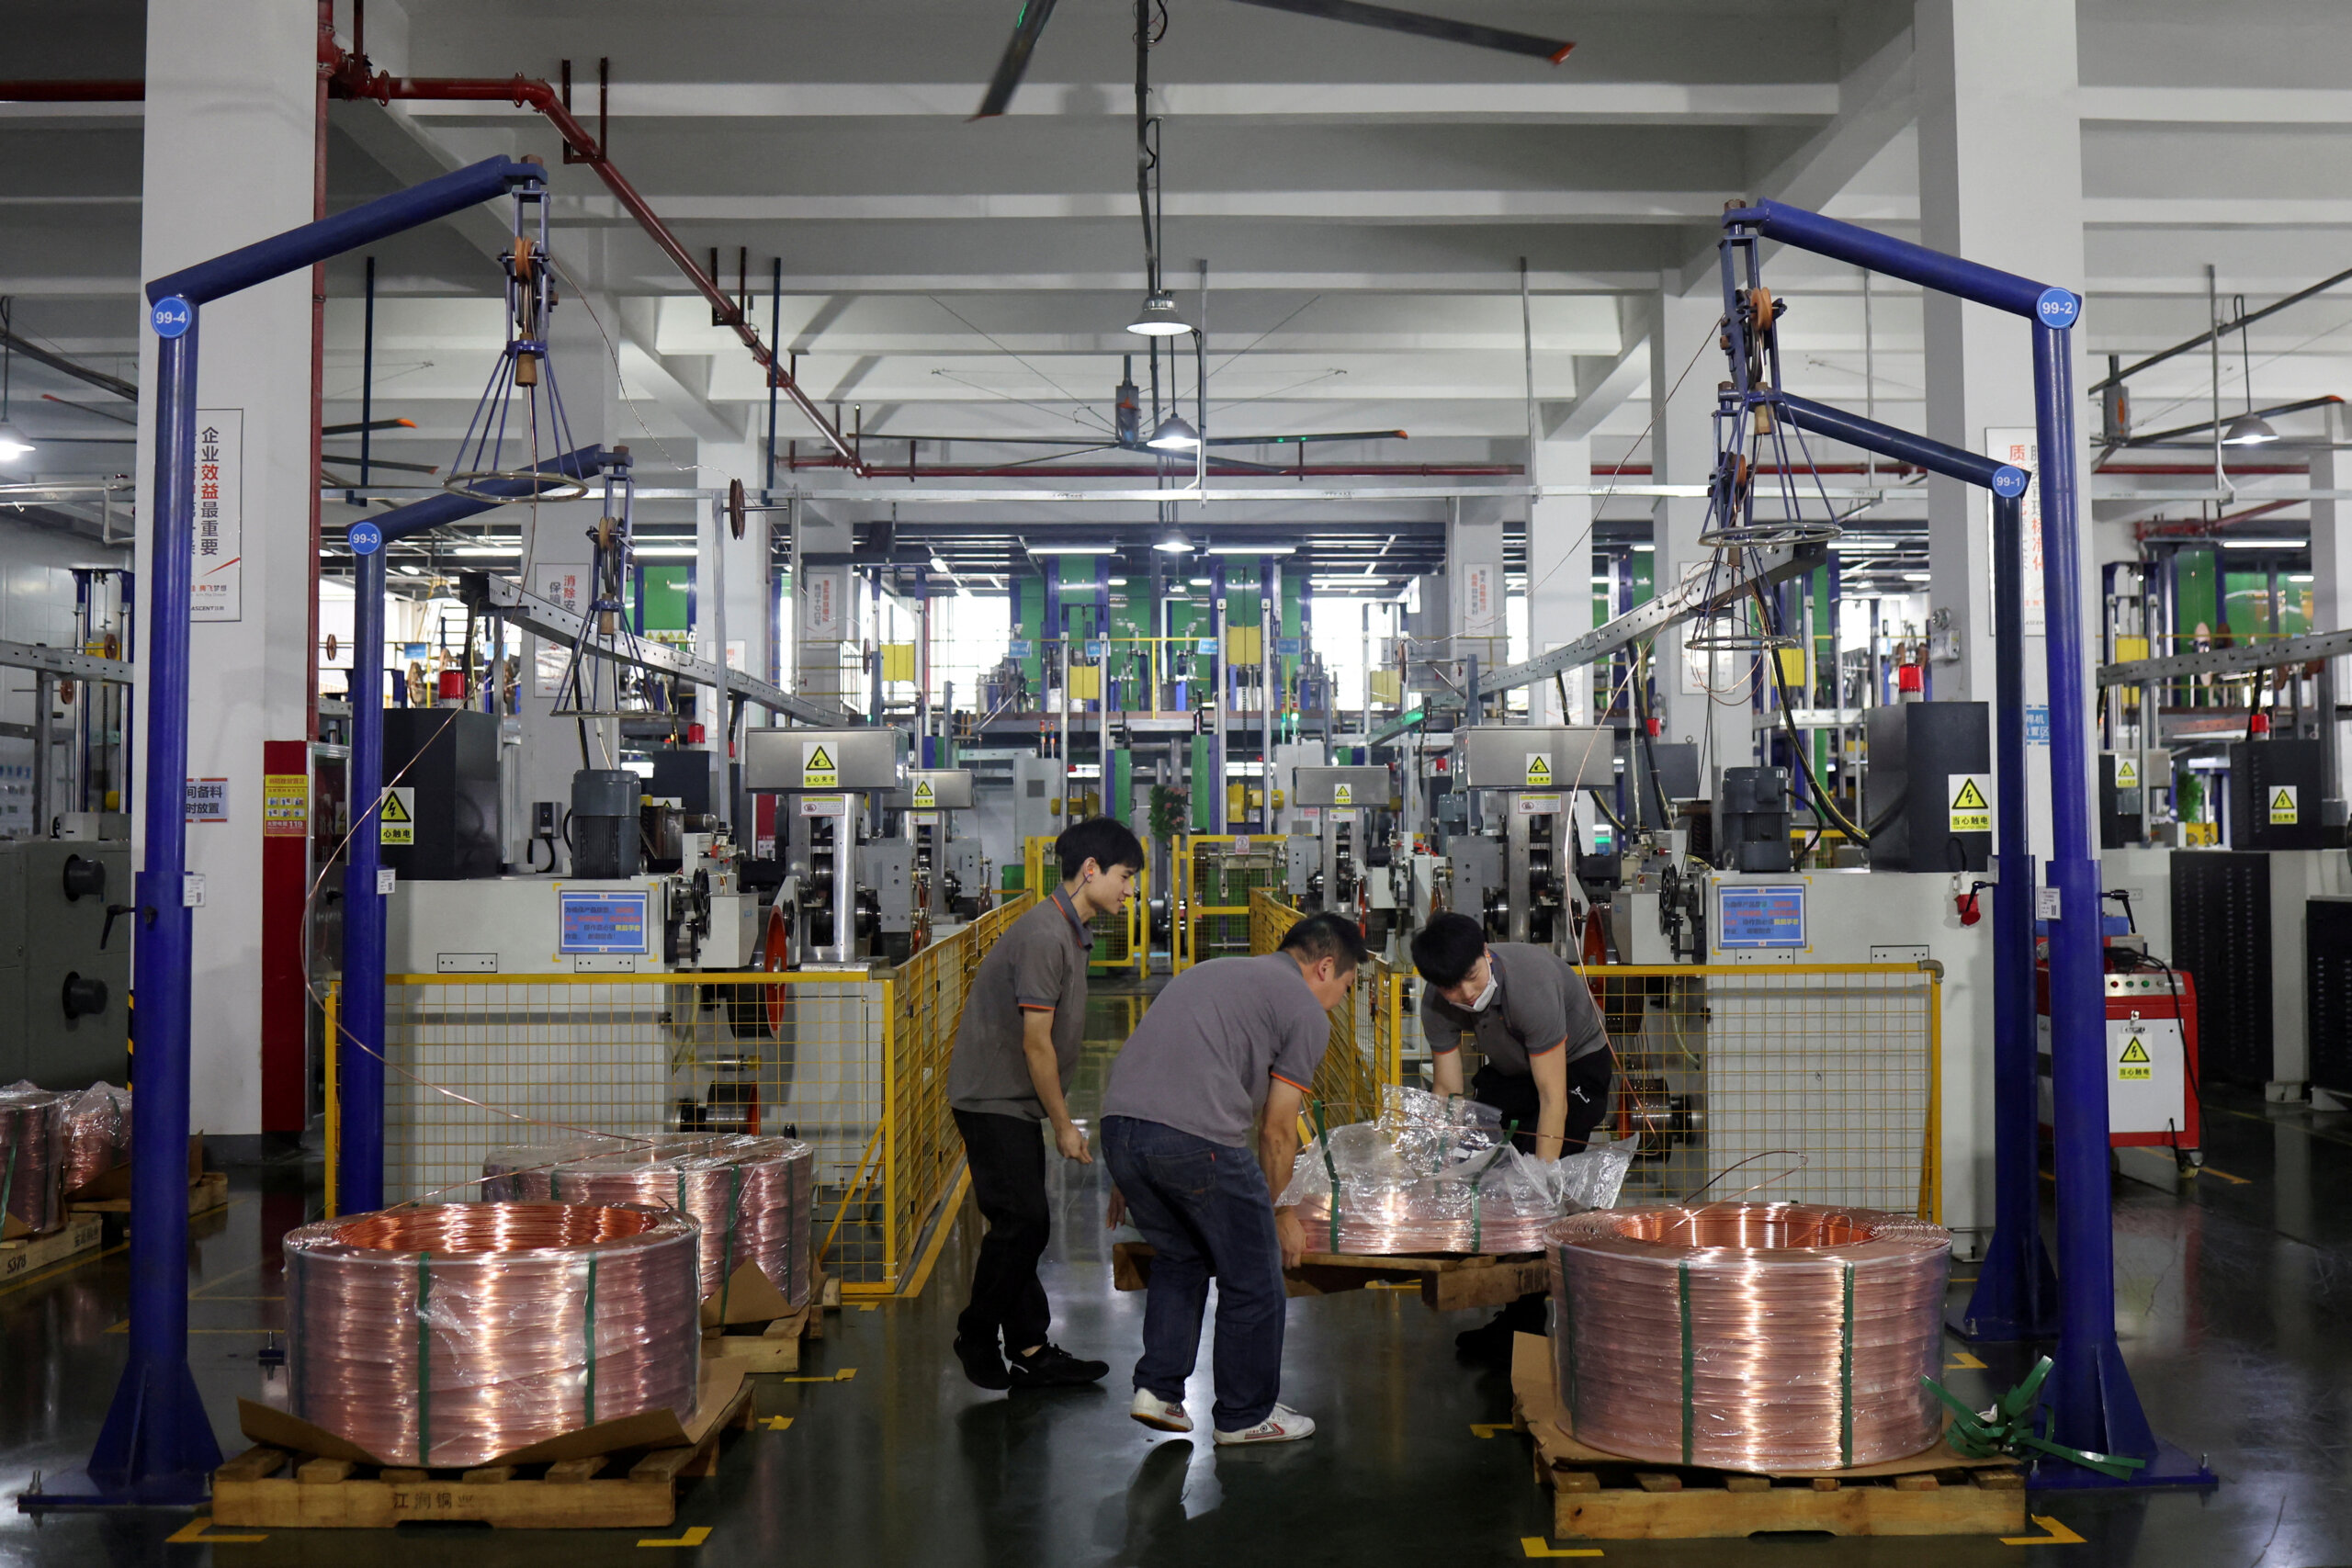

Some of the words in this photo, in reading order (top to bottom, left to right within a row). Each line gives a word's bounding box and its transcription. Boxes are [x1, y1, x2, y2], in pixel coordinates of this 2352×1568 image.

[2042, 301, 2073, 314] 99-2
[155, 310, 187, 323] 99-4
[1996, 476, 2020, 487] 99-1
[200, 426, 219, 556] 企业效益最重要
[353, 533, 378, 544] 99-3
[187, 785, 222, 798] 间备料
[186, 803, 220, 814] 时放置
[1952, 816, 1988, 825] 当心触电
[383, 829, 411, 839] 心触电
